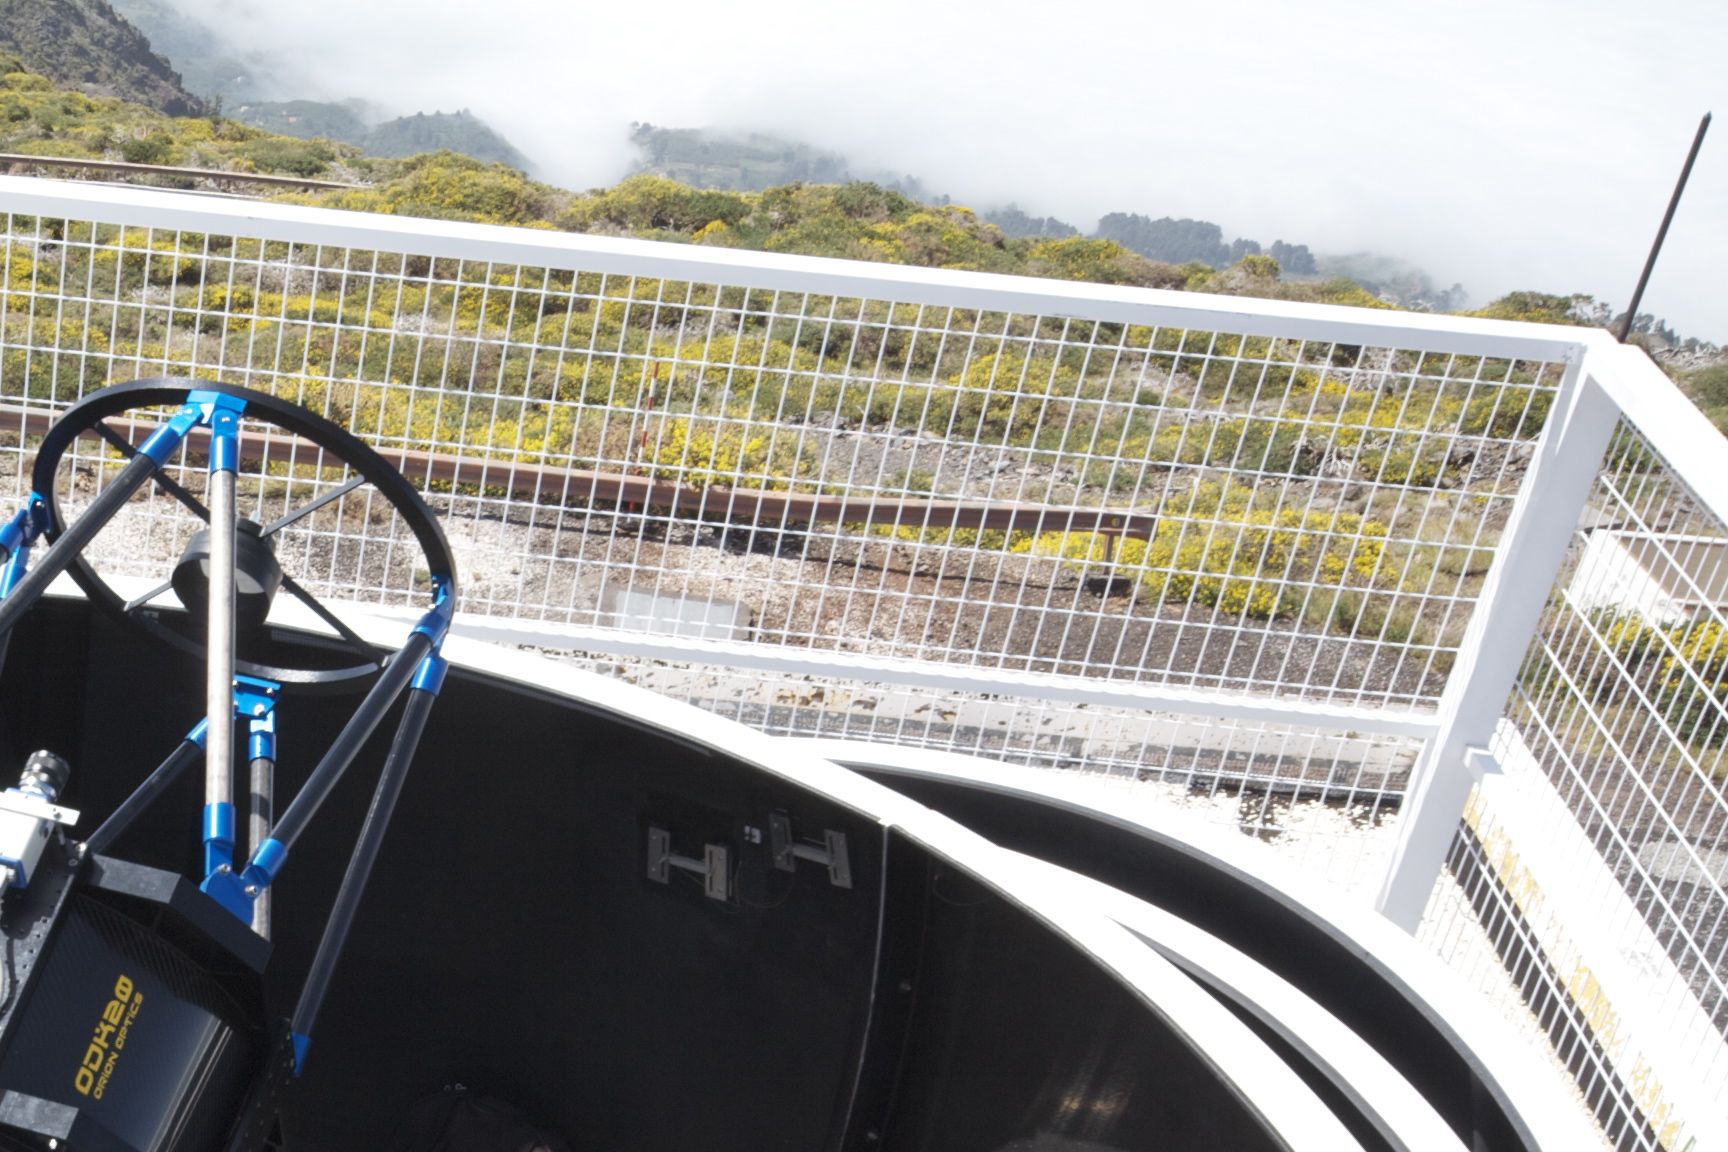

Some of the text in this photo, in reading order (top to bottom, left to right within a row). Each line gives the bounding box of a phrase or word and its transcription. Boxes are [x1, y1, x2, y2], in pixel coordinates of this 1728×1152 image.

[74, 974, 134, 1096] ODK20
[93, 991, 144, 1100] ORION OPTICS
